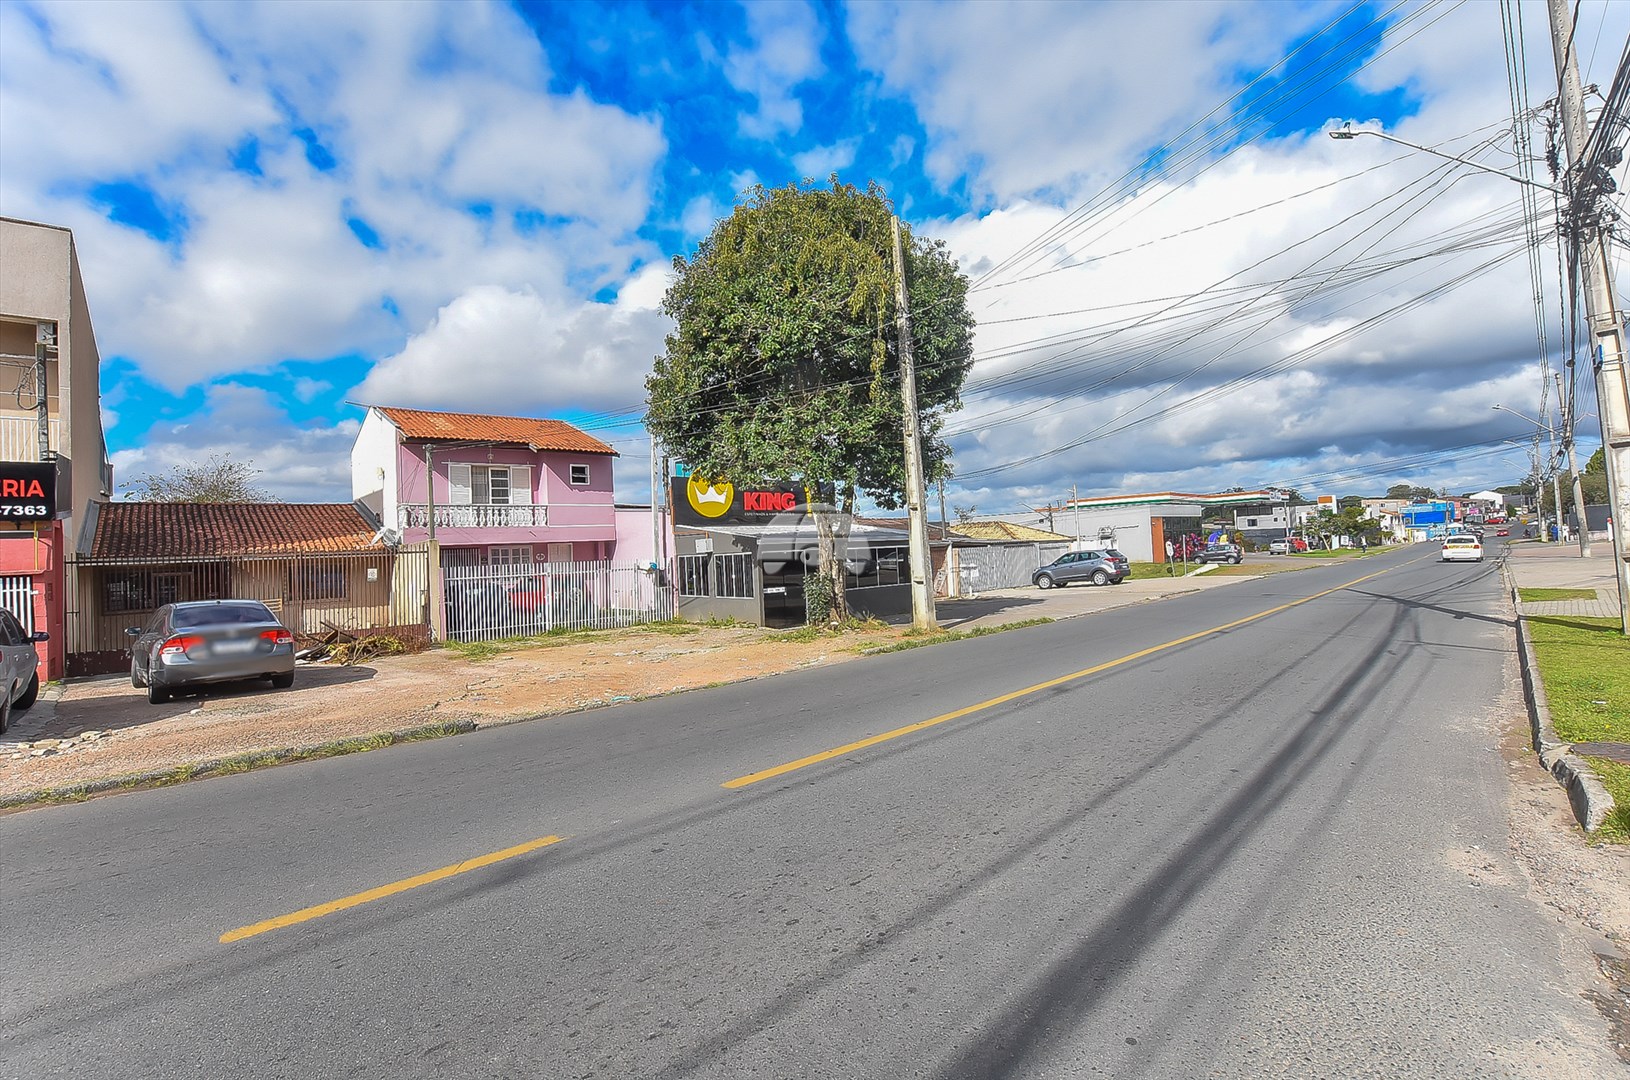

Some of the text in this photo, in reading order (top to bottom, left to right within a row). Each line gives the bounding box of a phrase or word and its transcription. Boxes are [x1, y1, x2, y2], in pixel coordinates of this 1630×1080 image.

[0, 479, 45, 498] RIA
[0, 505, 47, 516] 7363
[744, 491, 796, 511] KING
